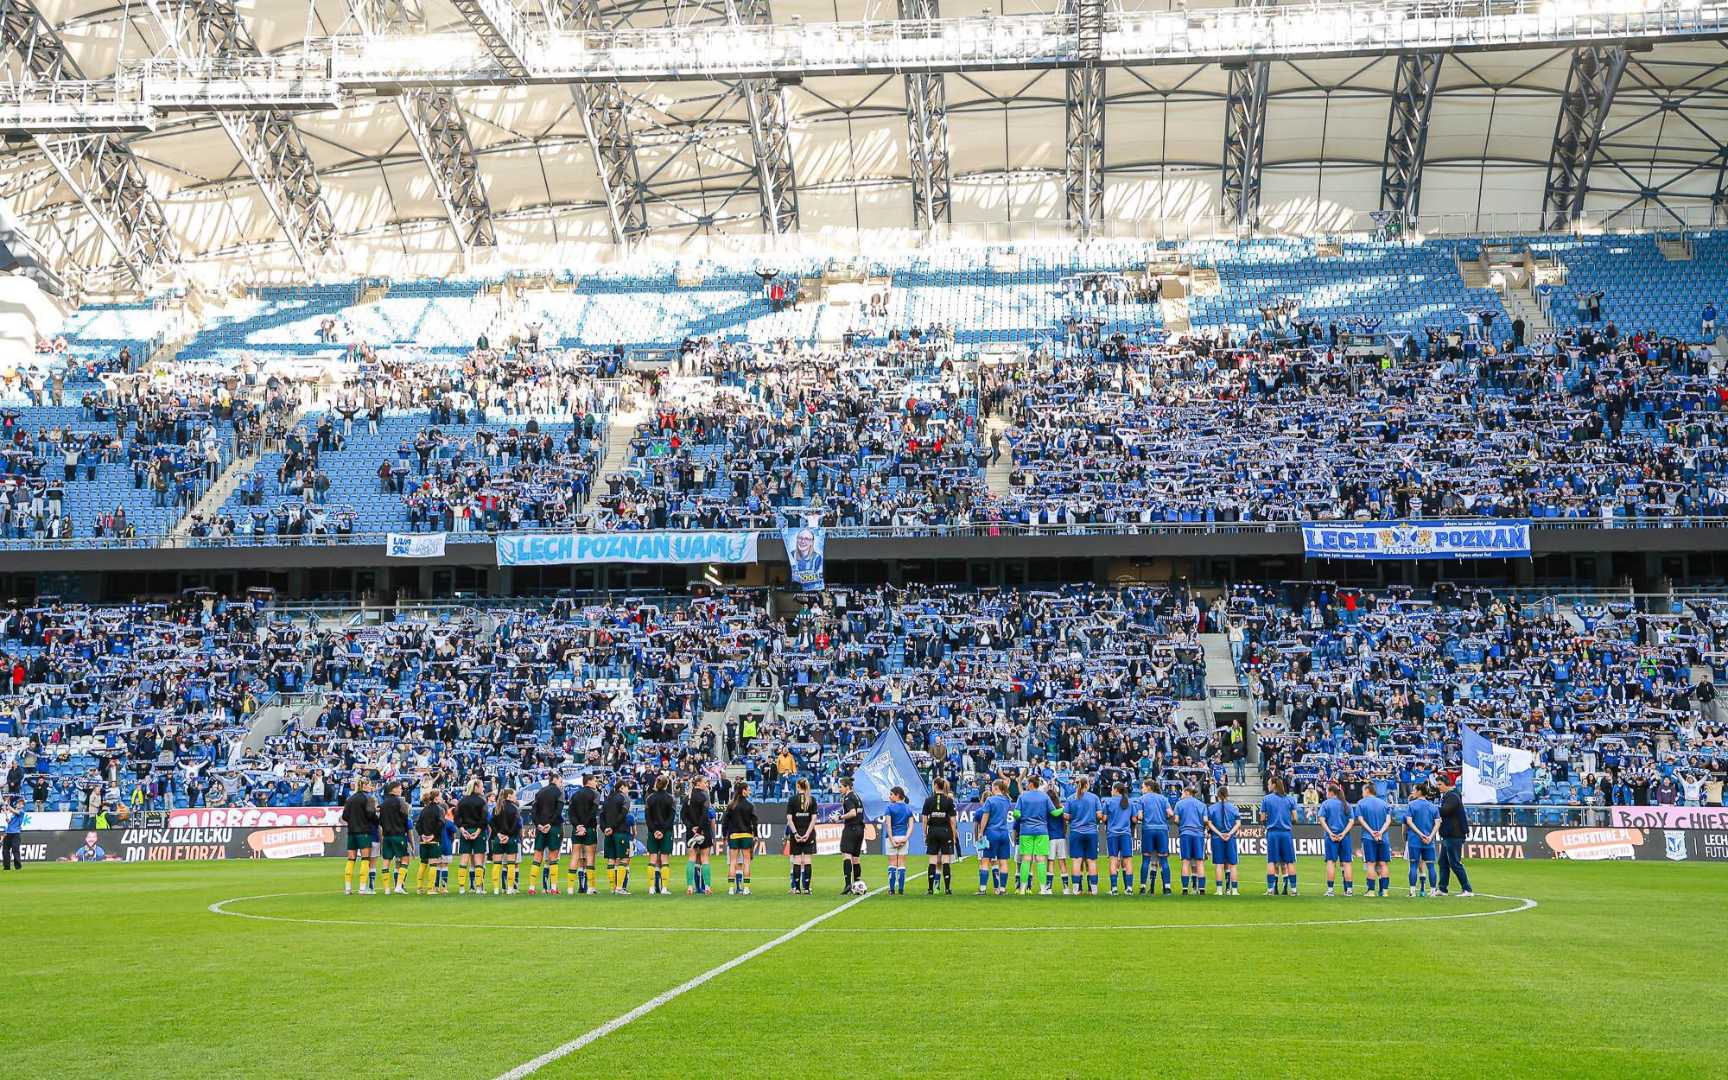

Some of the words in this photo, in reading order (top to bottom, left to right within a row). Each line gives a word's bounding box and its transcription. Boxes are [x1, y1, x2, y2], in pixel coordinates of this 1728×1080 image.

[1304, 529, 1377, 550] LECH
[1434, 523, 1526, 548] POZNAŃ
[517, 535, 573, 561] LECH
[577, 532, 670, 560] POZNAŃ
[673, 535, 726, 560] UAM
[1618, 811, 1668, 828] BODY
[120, 828, 170, 843] ZAPISZ
[1704, 834, 1728, 846] LECH
[125, 846, 145, 861] DO
[148, 845, 225, 859] KOLEJORZA
